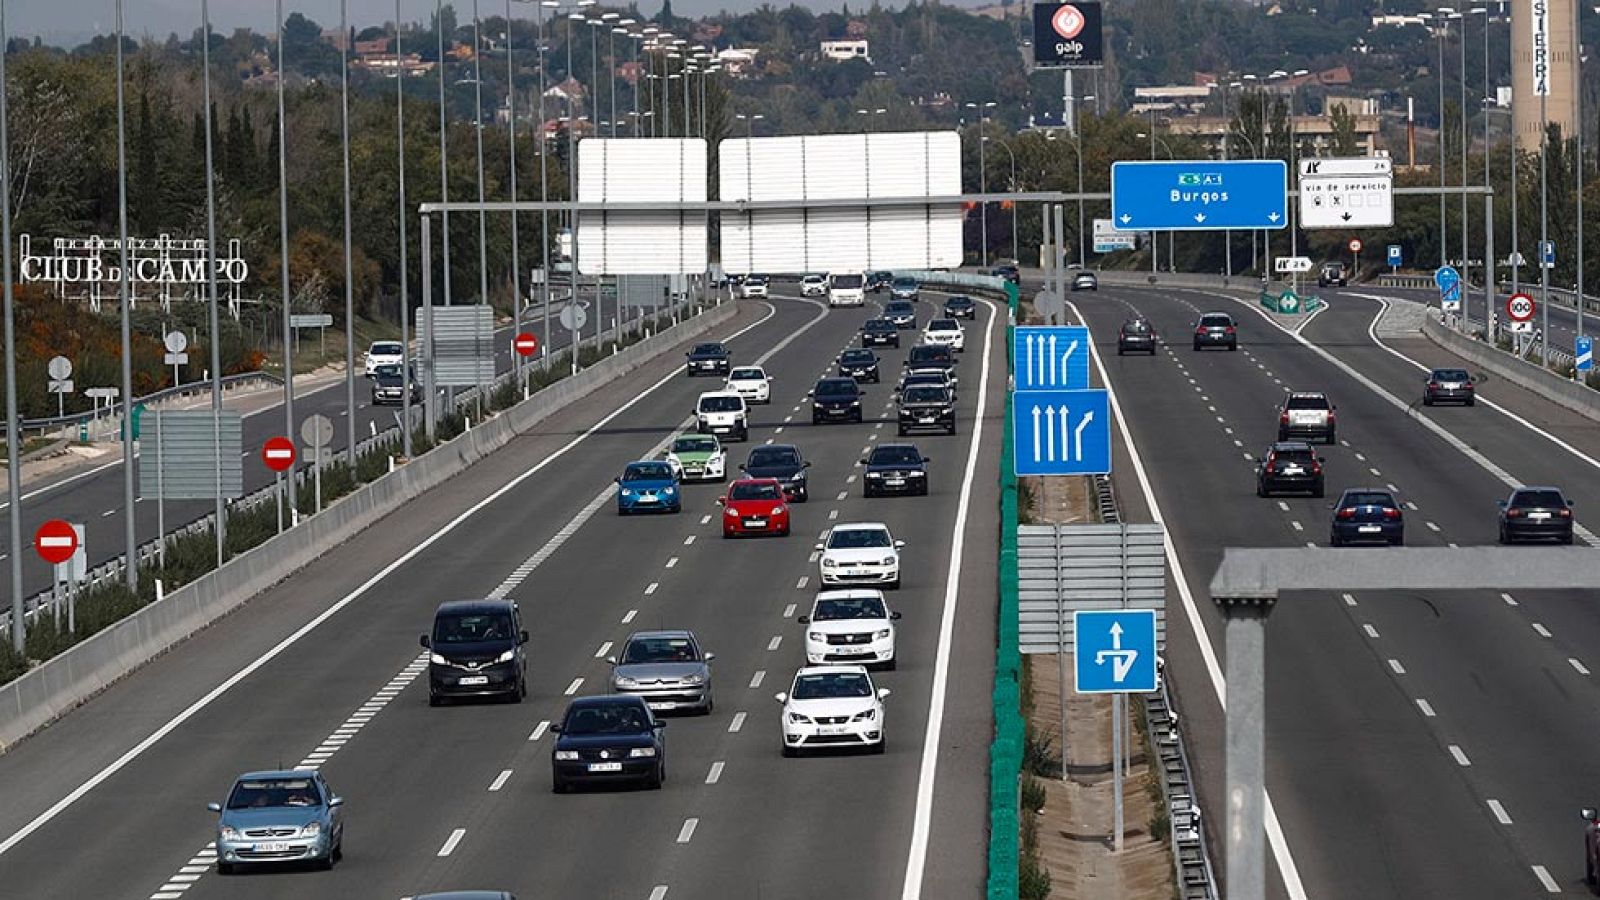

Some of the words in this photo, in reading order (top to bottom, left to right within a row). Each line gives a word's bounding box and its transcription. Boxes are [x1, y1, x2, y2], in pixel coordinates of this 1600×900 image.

[1055, 41, 1083, 55] galp
[1534, 3, 1547, 94] SIERRA
[1374, 162, 1386, 170] 26
[1345, 183, 1387, 191] servicio
[1170, 189, 1229, 205] Burgos
[21, 256, 103, 282] CLUB
[137, 257, 248, 284] CAMPO
[1512, 302, 1530, 312] 100
